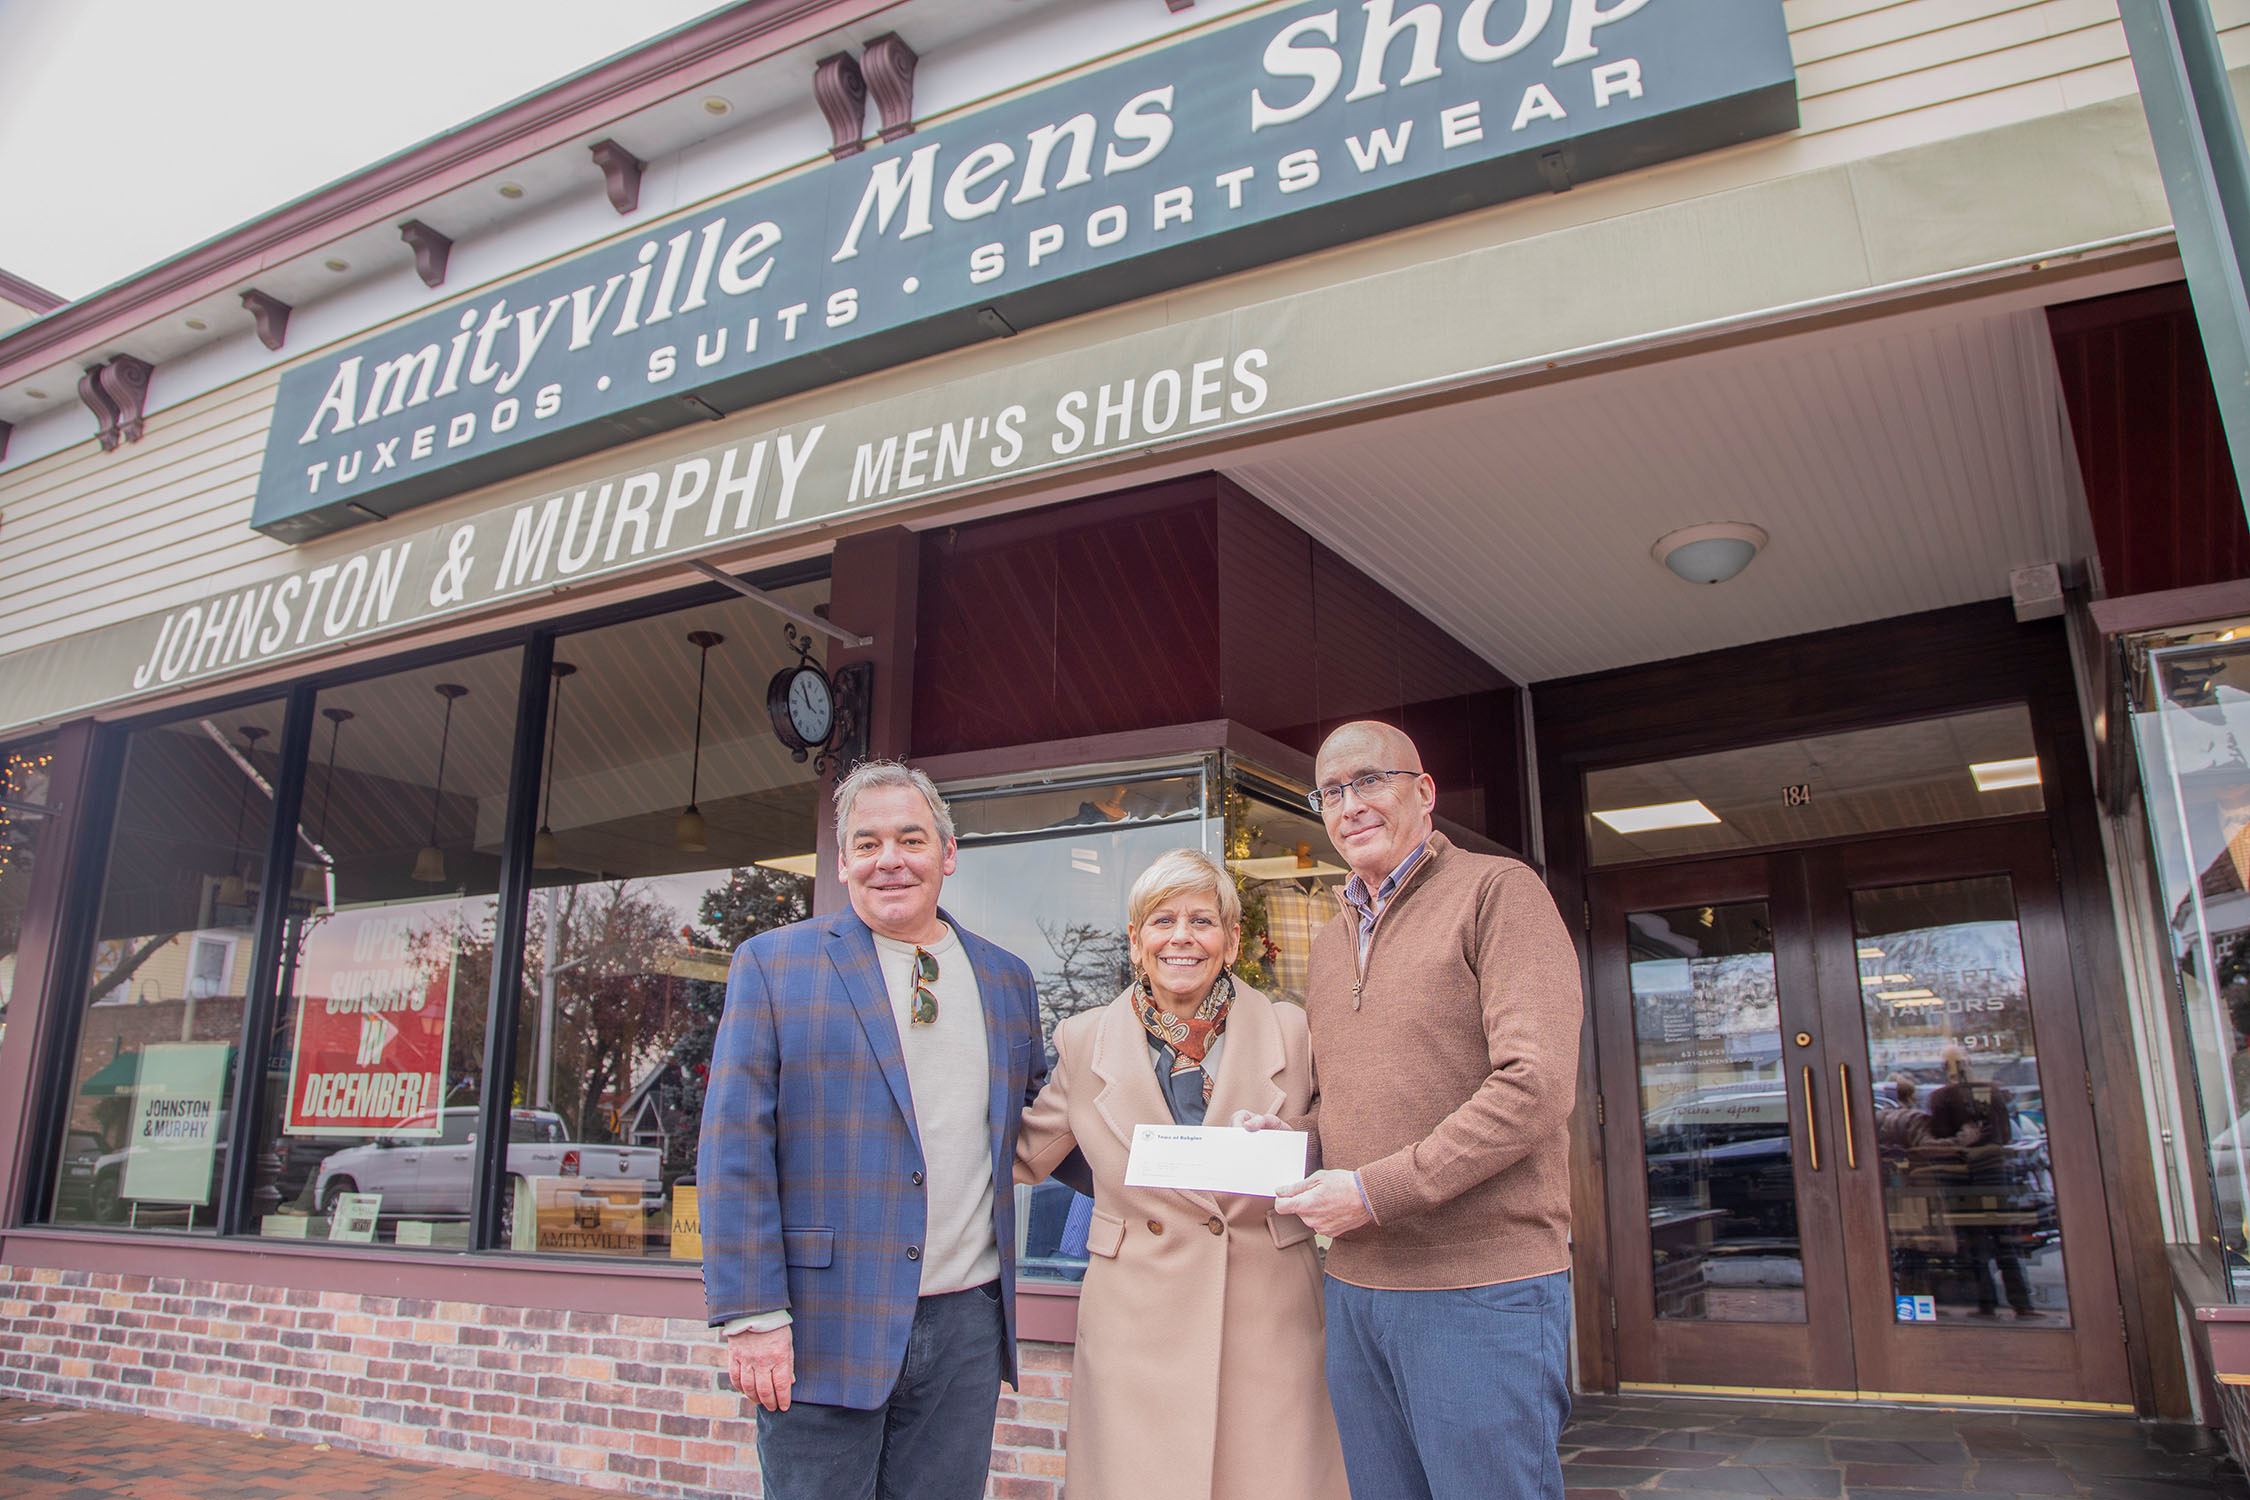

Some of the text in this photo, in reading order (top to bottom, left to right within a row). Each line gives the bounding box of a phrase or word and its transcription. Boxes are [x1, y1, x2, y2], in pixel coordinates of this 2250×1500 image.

[299, 217, 782, 444] Amityville
[832, 85, 1174, 262] Mens
[307, 57, 1643, 493] TUXEDOS SUITS SPORTSWEAR
[133, 348, 1268, 689] JOHNSTON & MURPHY MEN'S SHOES
[1782, 784, 1811, 807] 184
[353, 916, 415, 962] OPEN
[326, 967, 426, 1015] SUNDAYS
[1884, 996, 2005, 1017] TAILORS
[356, 1014, 387, 1065] IN
[1951, 1034, 2001, 1048] 1911
[146, 1100, 211, 1117] JOHNSTON
[301, 1072, 432, 1118] DECEMBER!
[1727, 1105, 1760, 1118] 4pm
[539, 1232, 638, 1250] AMITYVILLE
